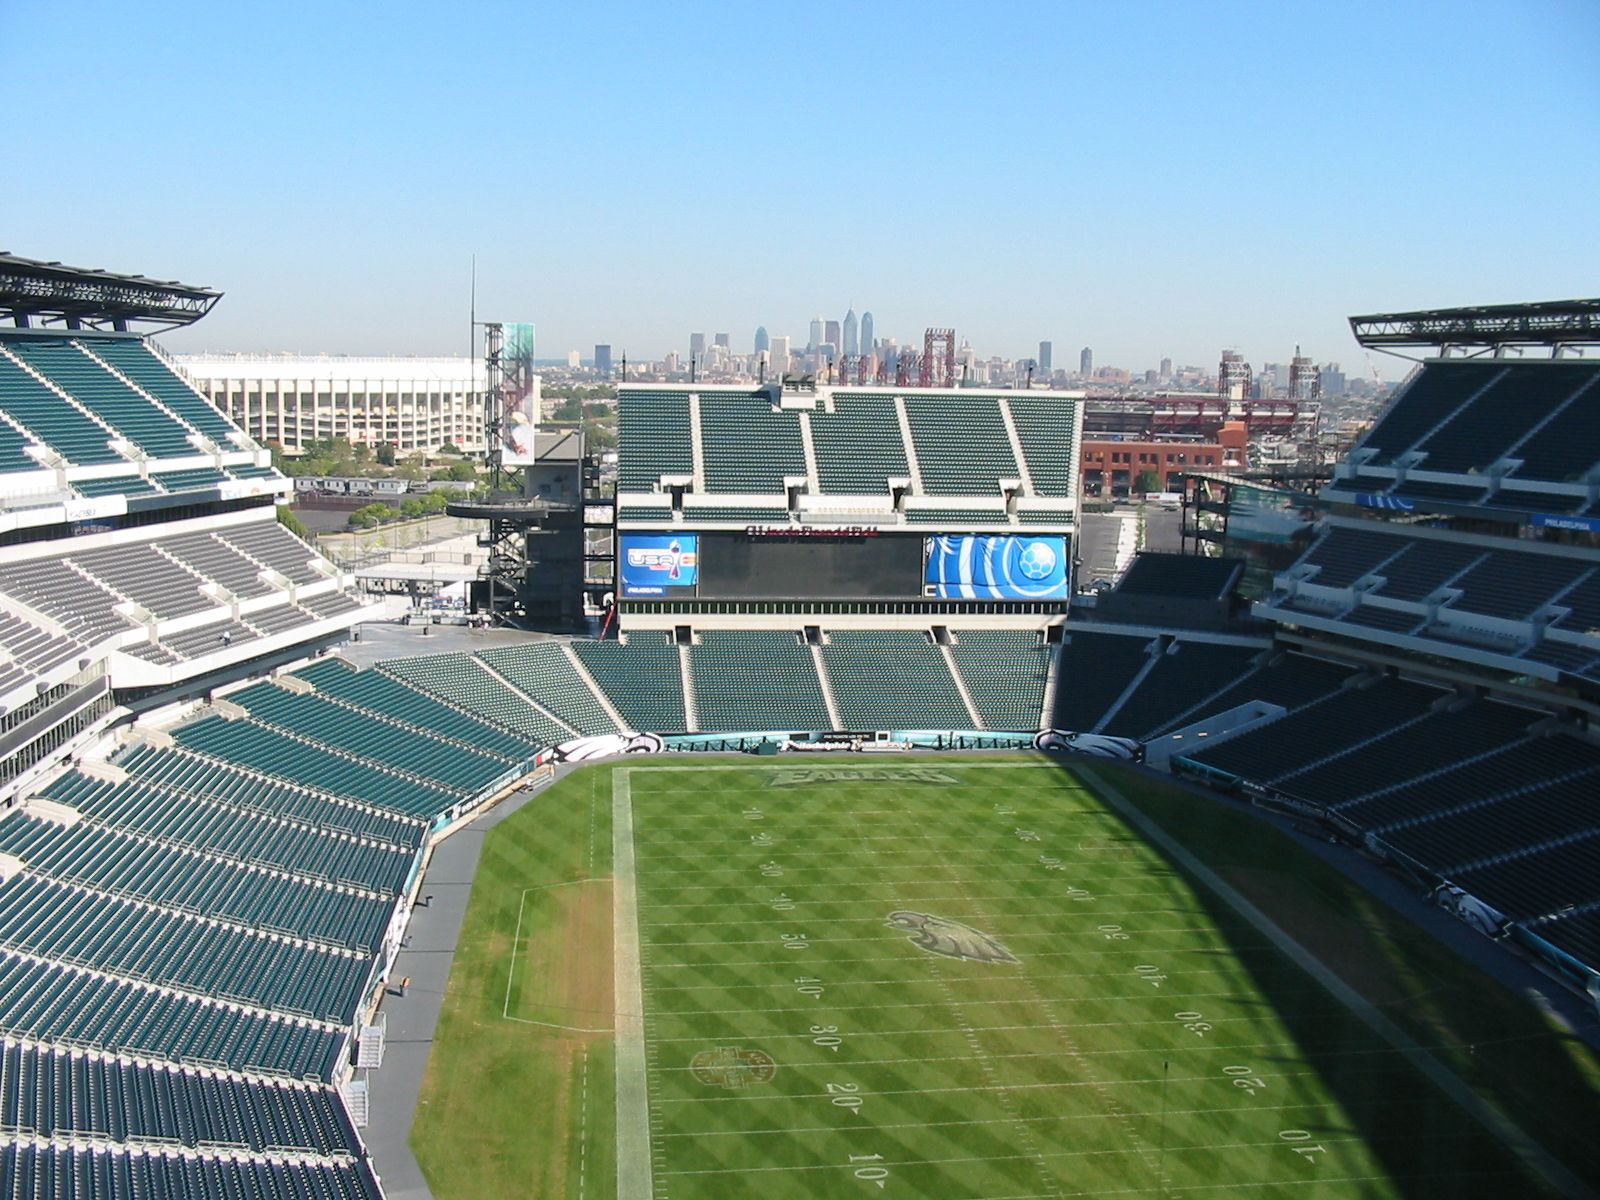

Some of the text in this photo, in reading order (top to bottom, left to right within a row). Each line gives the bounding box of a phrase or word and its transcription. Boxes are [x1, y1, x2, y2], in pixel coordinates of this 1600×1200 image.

[629, 554, 674, 566] USA
[770, 768, 959, 786] EAGLES
[780, 933, 809, 950] 50
[1098, 925, 1130, 940] 50
[1134, 964, 1167, 983] 40
[794, 976, 825, 995] 40
[1174, 1011, 1212, 1035] 30
[810, 1025, 842, 1046] 30
[1222, 1065, 1268, 1089] 20
[826, 1082, 863, 1108] 20
[1278, 1130, 1328, 1155] 10
[848, 1152, 889, 1181] 10
